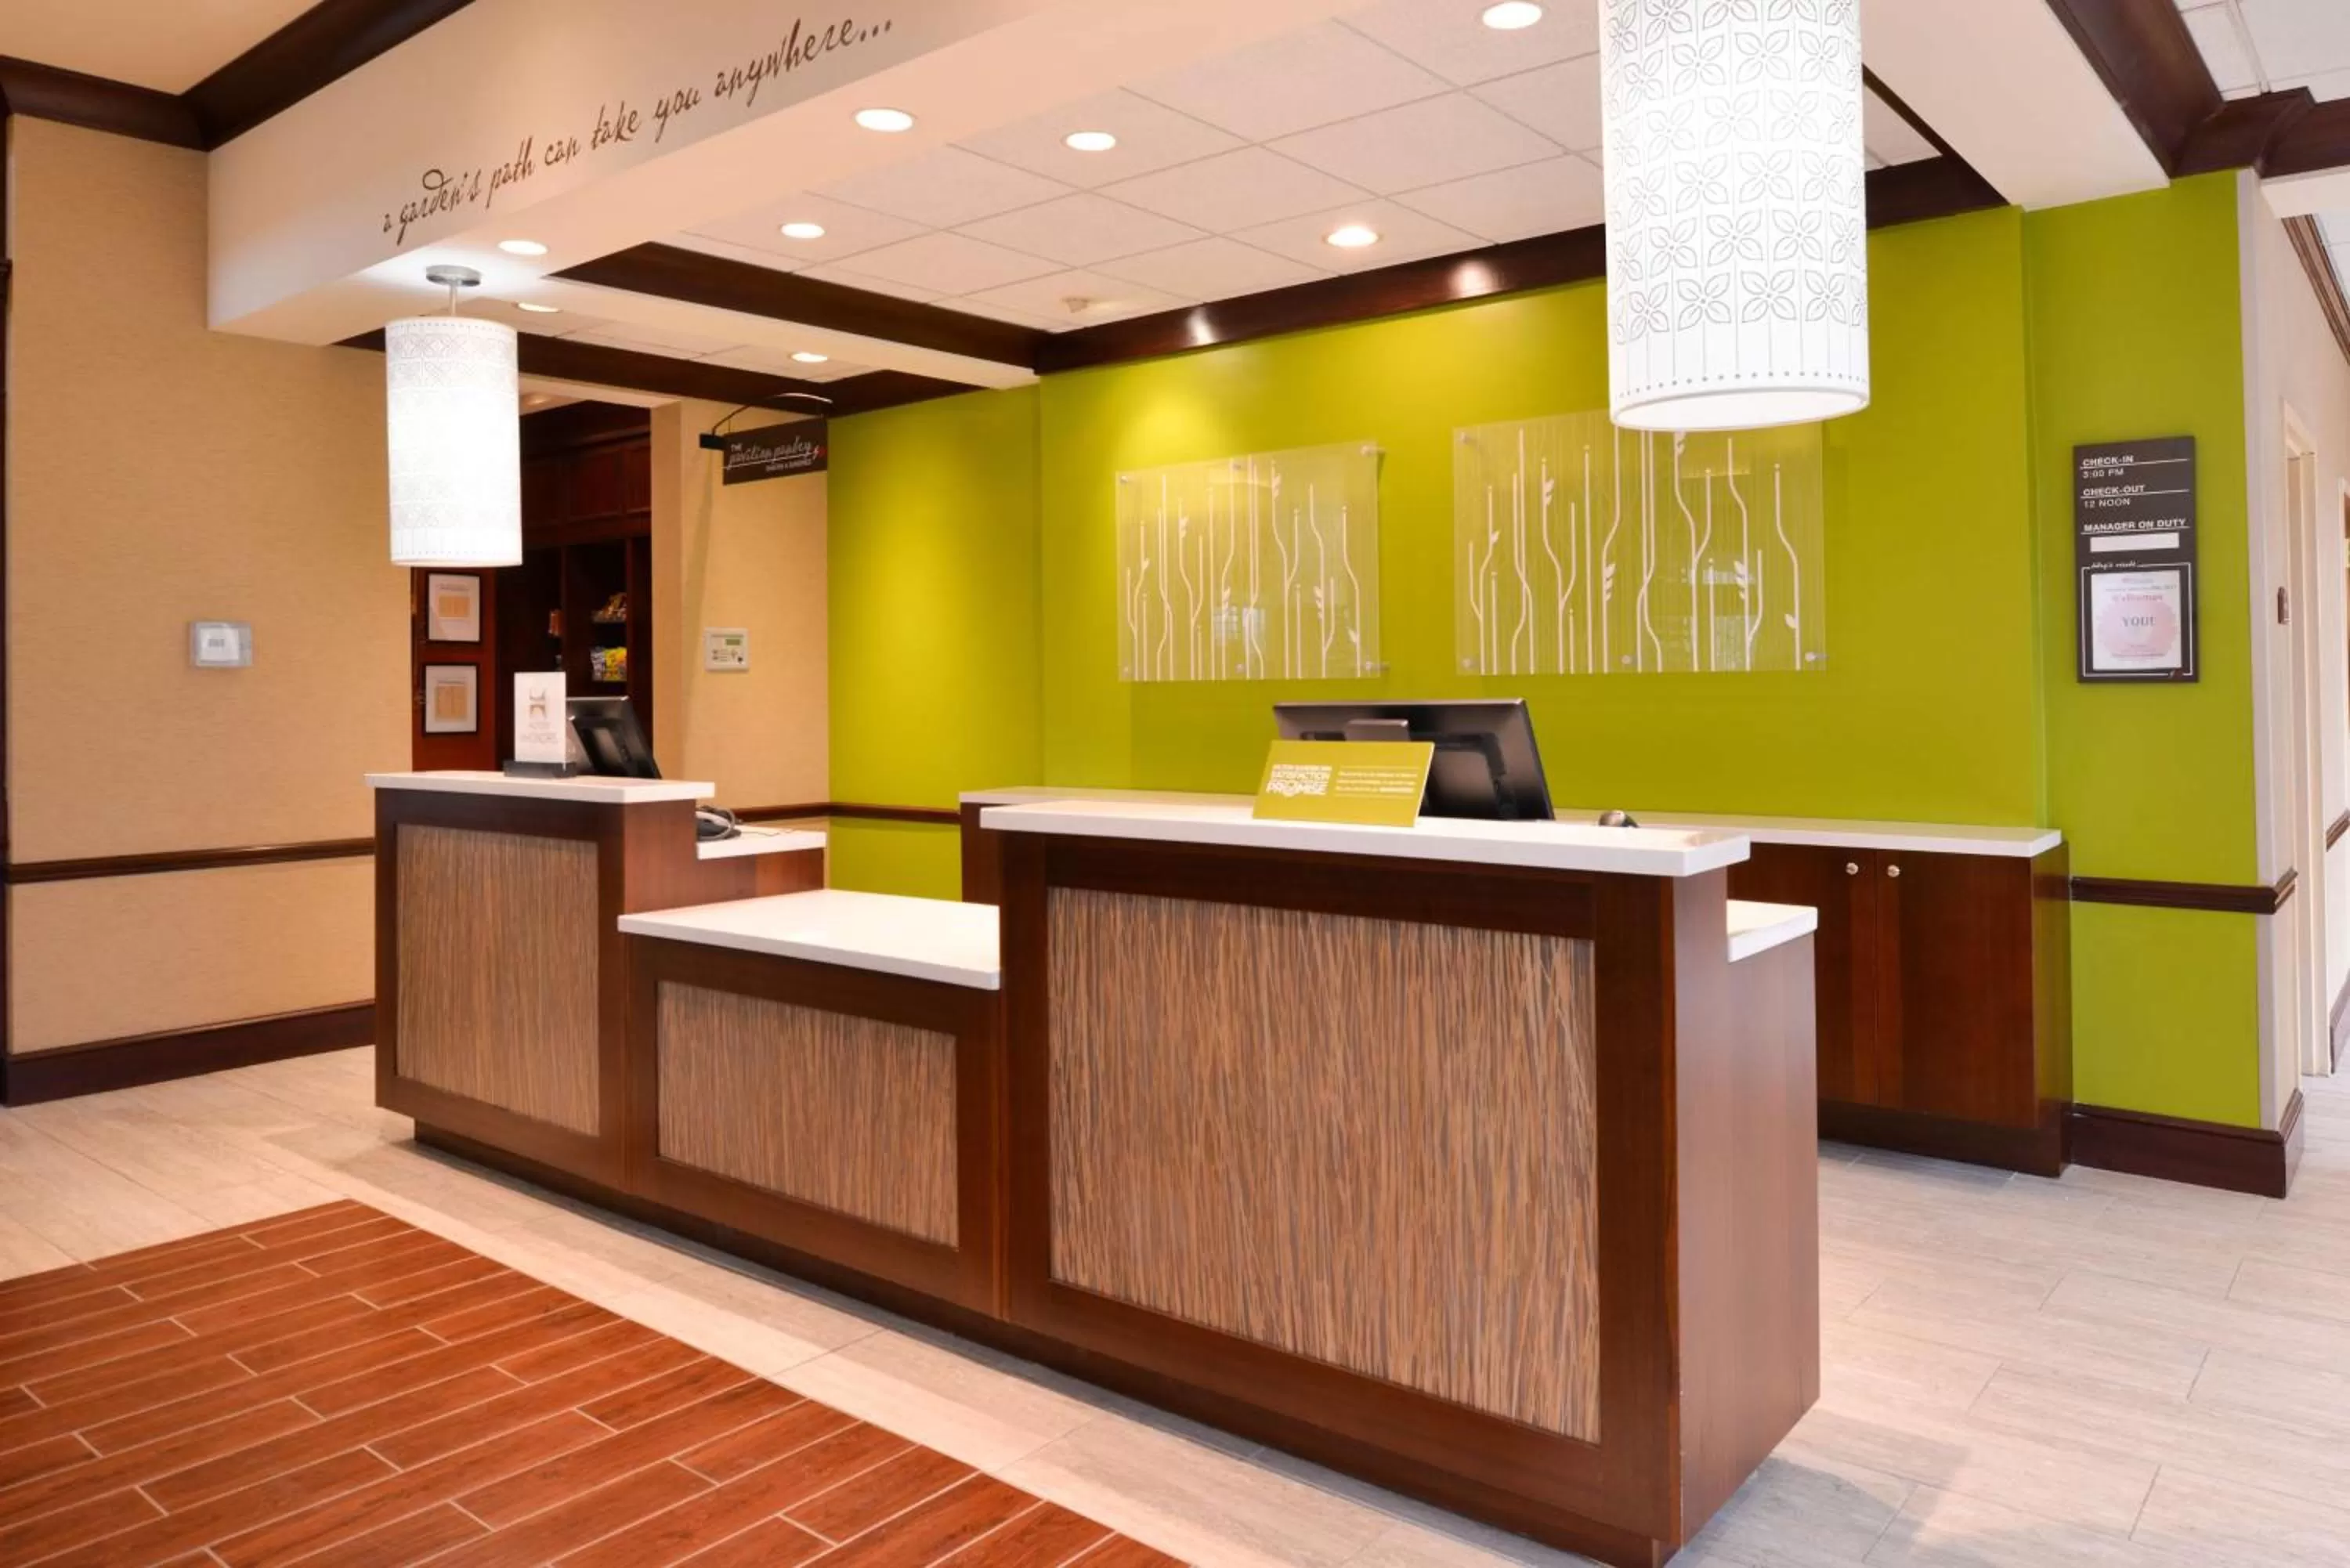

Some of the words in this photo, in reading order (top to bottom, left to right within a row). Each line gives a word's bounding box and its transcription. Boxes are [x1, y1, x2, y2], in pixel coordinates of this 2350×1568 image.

[382, 212, 392, 233] a
[396, 168, 482, 247] garden's
[485, 135, 534, 210] path
[544, 137, 580, 167] can
[591, 101, 641, 144] take
[653, 86, 701, 144] you
[2082, 455, 2135, 467] CHECK-IN
[2083, 470, 2105, 479] 3:00
[2108, 468, 2124, 477] PM
[2083, 485, 2145, 497] CHECK-OUT
[2084, 500, 2095, 509] 12
[2099, 497, 2131, 508] NOON
[2084, 522, 2135, 533] MANAGER
[2138, 520, 2154, 529] ON
[2157, 518, 2186, 528] DUTY
